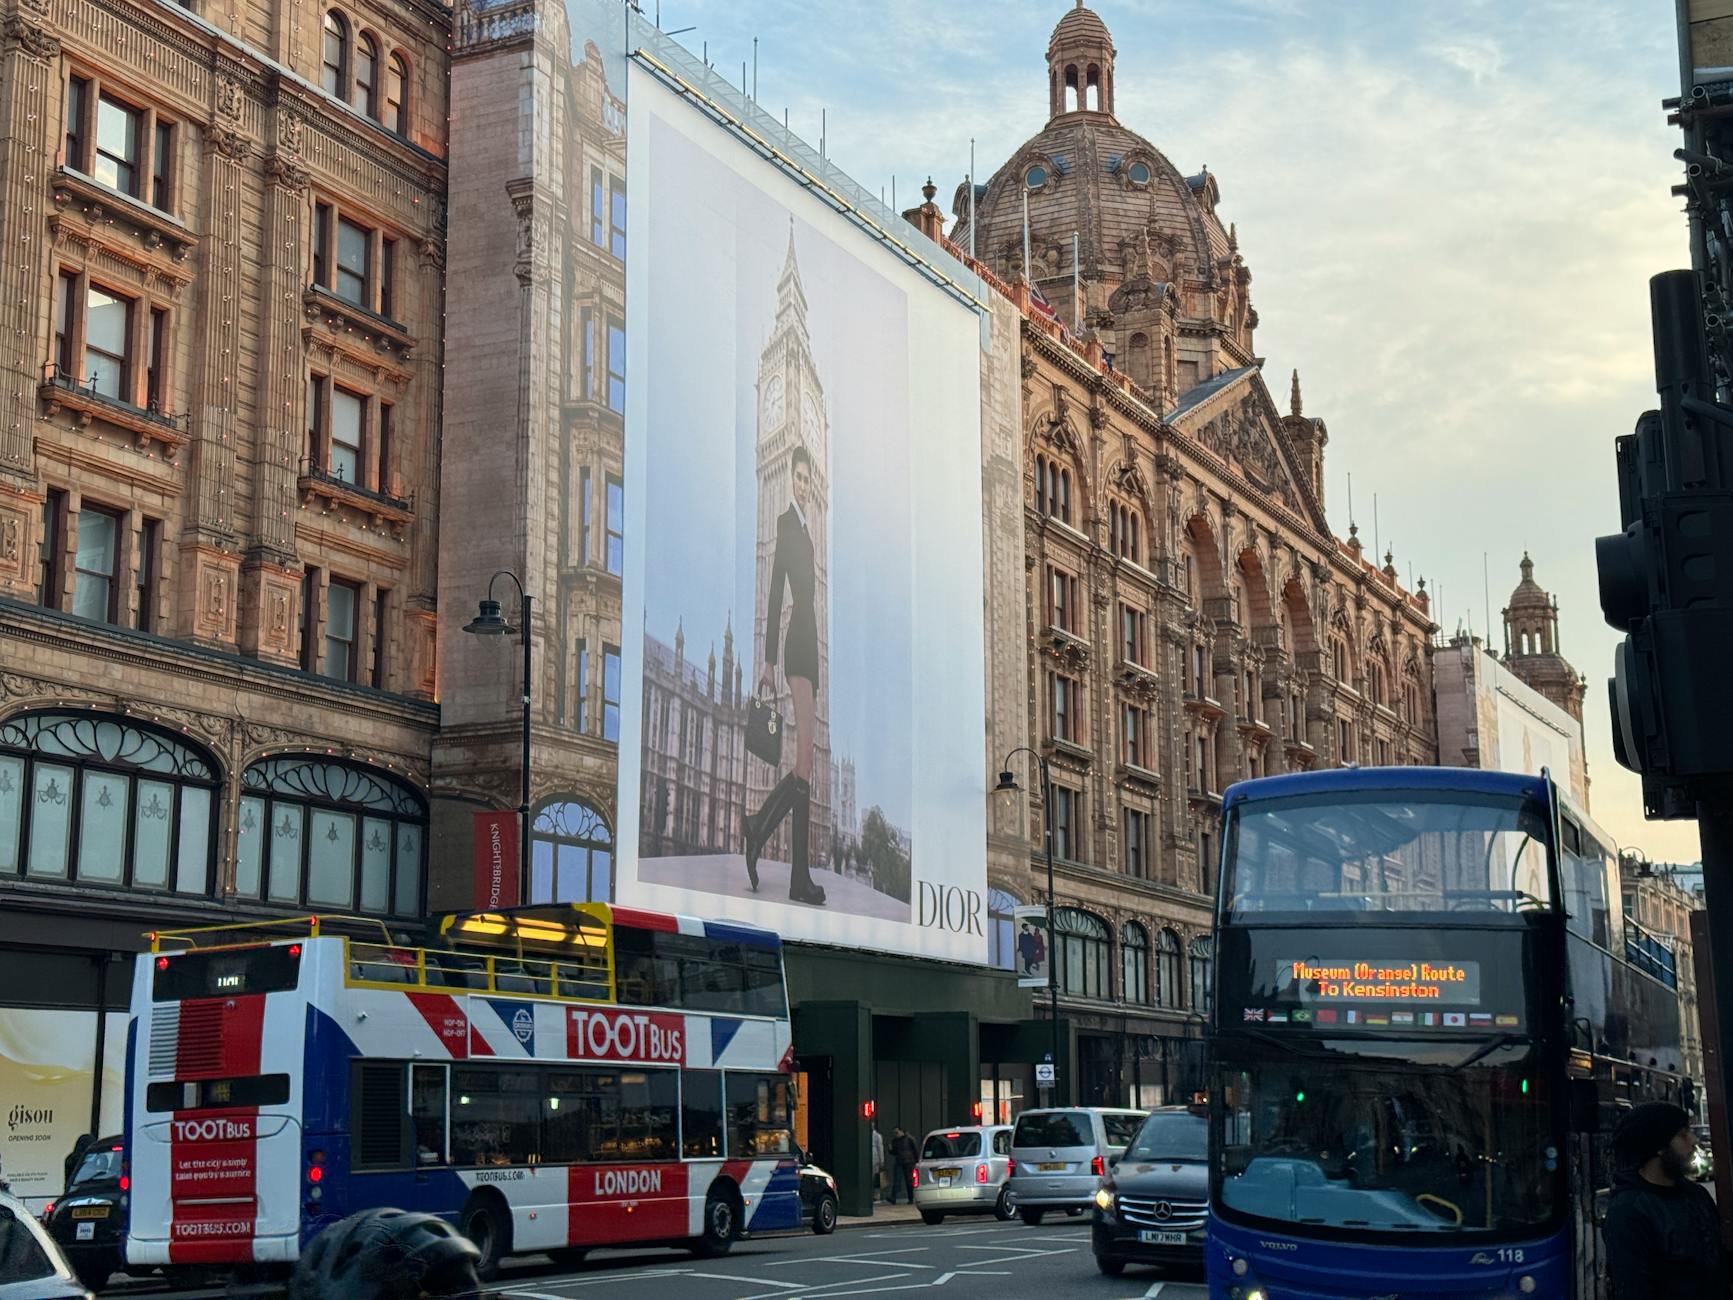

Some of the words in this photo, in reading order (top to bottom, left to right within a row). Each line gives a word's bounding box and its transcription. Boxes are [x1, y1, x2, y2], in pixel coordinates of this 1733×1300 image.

[918, 880, 984, 937] DIOR
[1293, 962, 1350, 980] Museum
[1421, 964, 1465, 981] Route
[1318, 981, 1338, 997] To
[1342, 982, 1439, 998] Kensington
[595, 1169, 662, 1195] LONDON
[1259, 1240, 1297, 1251] VOLVO
[1497, 1248, 1525, 1263] 118
